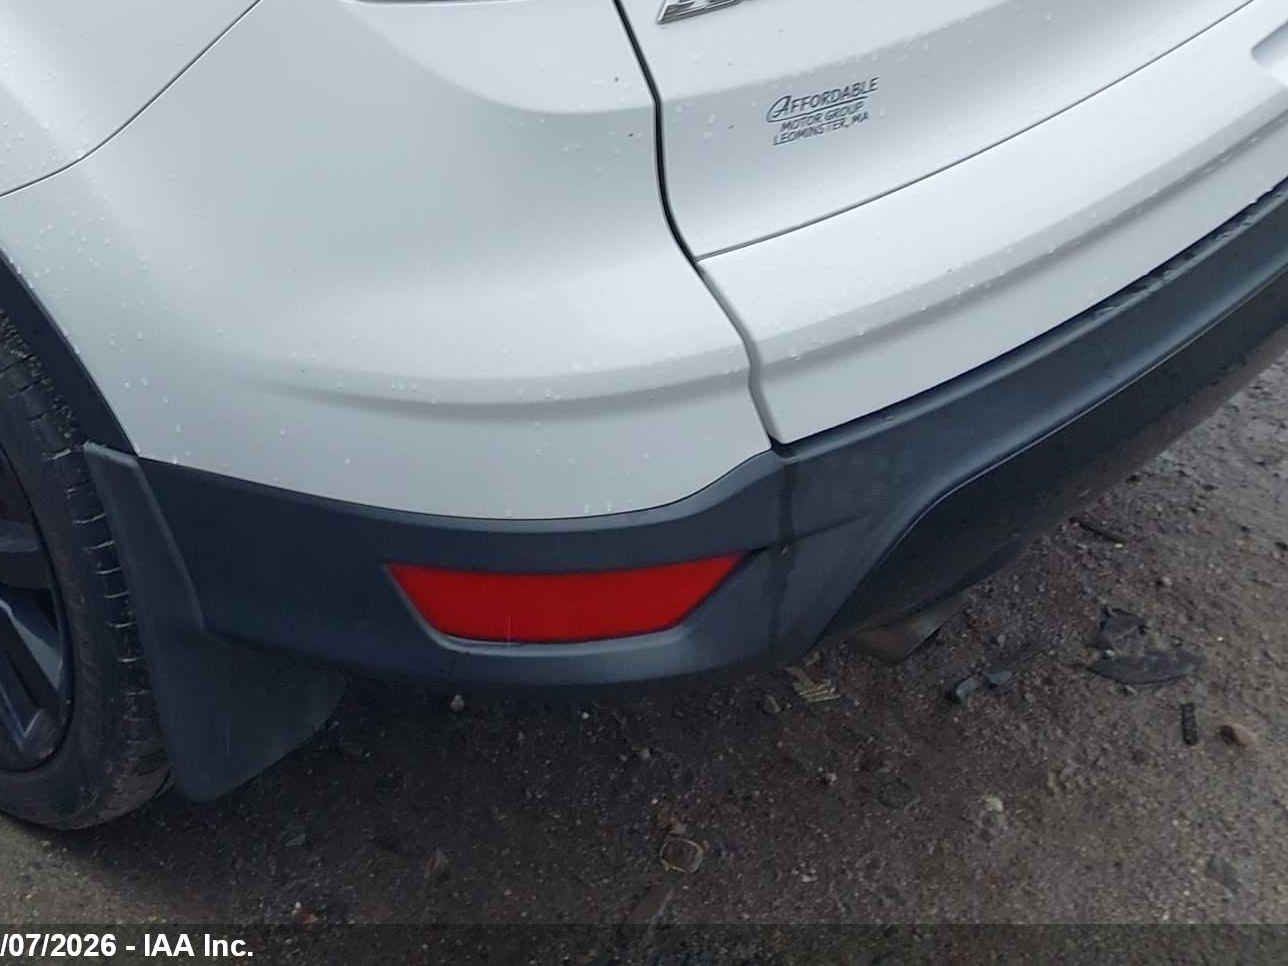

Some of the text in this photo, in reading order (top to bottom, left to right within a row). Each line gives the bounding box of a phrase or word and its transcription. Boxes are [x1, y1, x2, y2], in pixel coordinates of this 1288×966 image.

[766, 76, 880, 122] AFFORDABLE
[780, 101, 864, 133] MOTOR GROUP
[851, 111, 870, 125] MA
